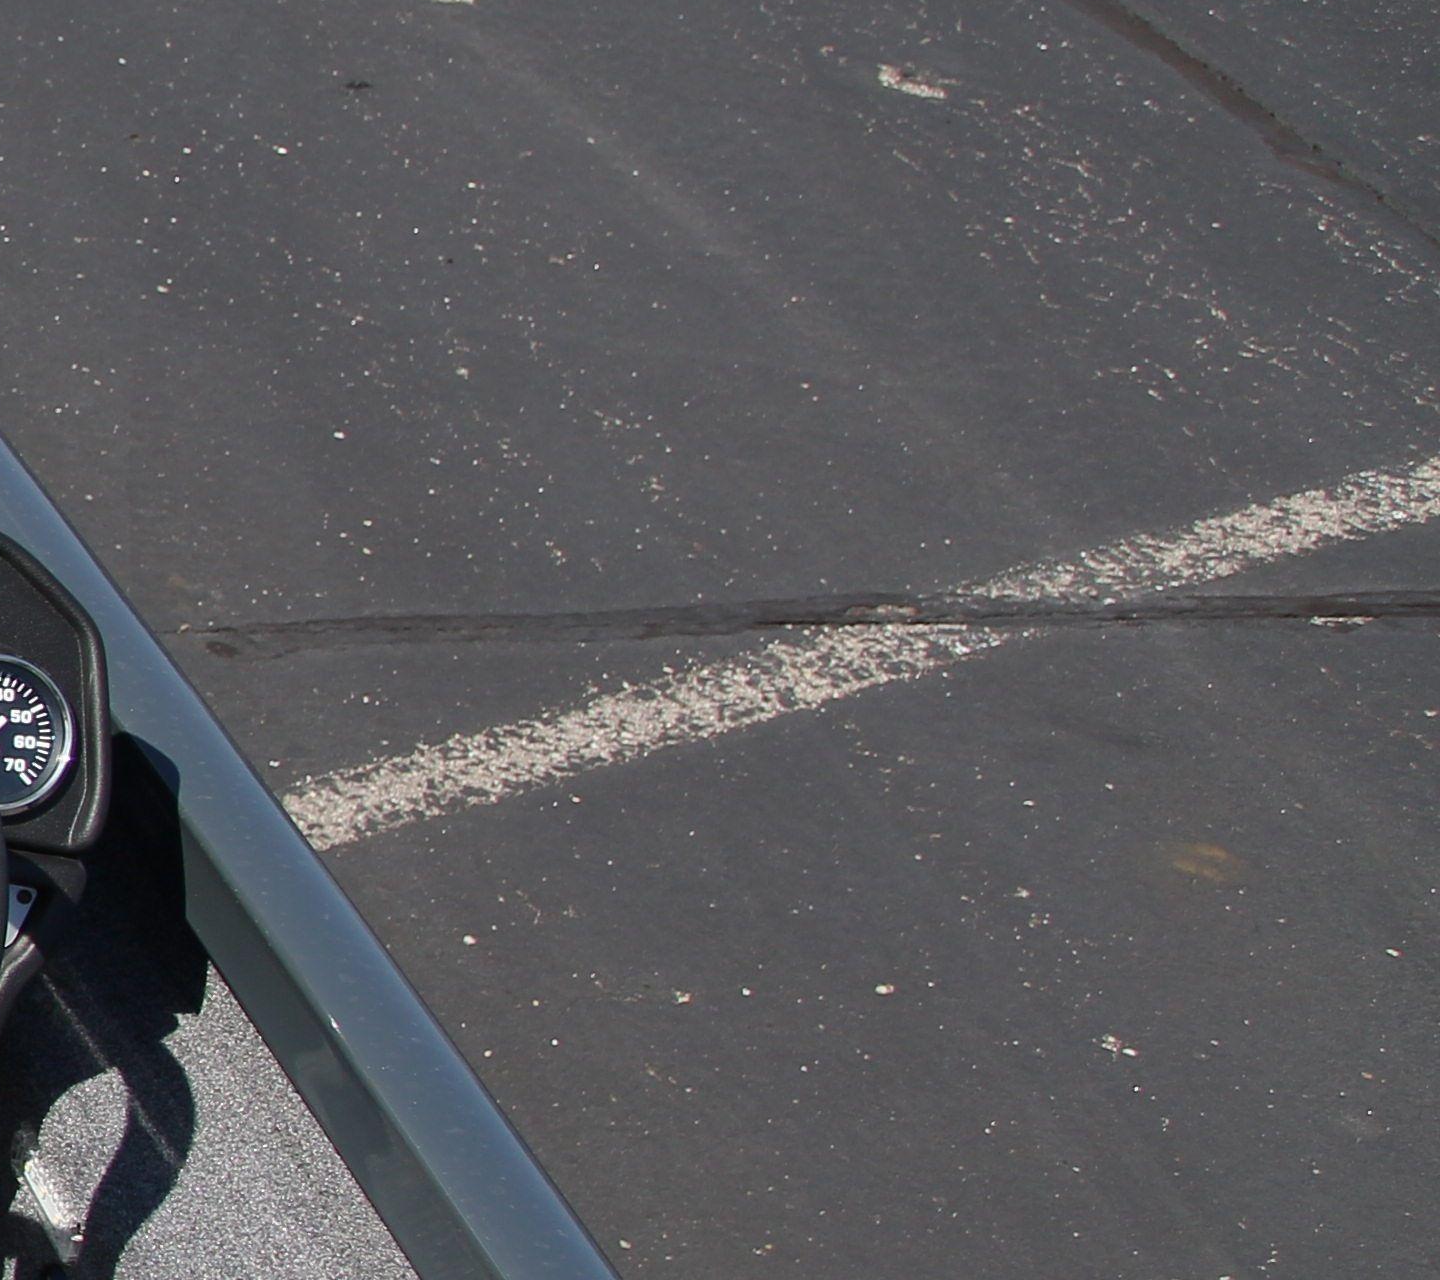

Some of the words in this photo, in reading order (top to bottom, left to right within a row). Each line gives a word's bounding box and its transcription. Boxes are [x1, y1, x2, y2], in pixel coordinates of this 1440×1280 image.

[10, 709, 32, 723] 50
[13, 735, 36, 749] 60
[3, 758, 26, 772] 70
